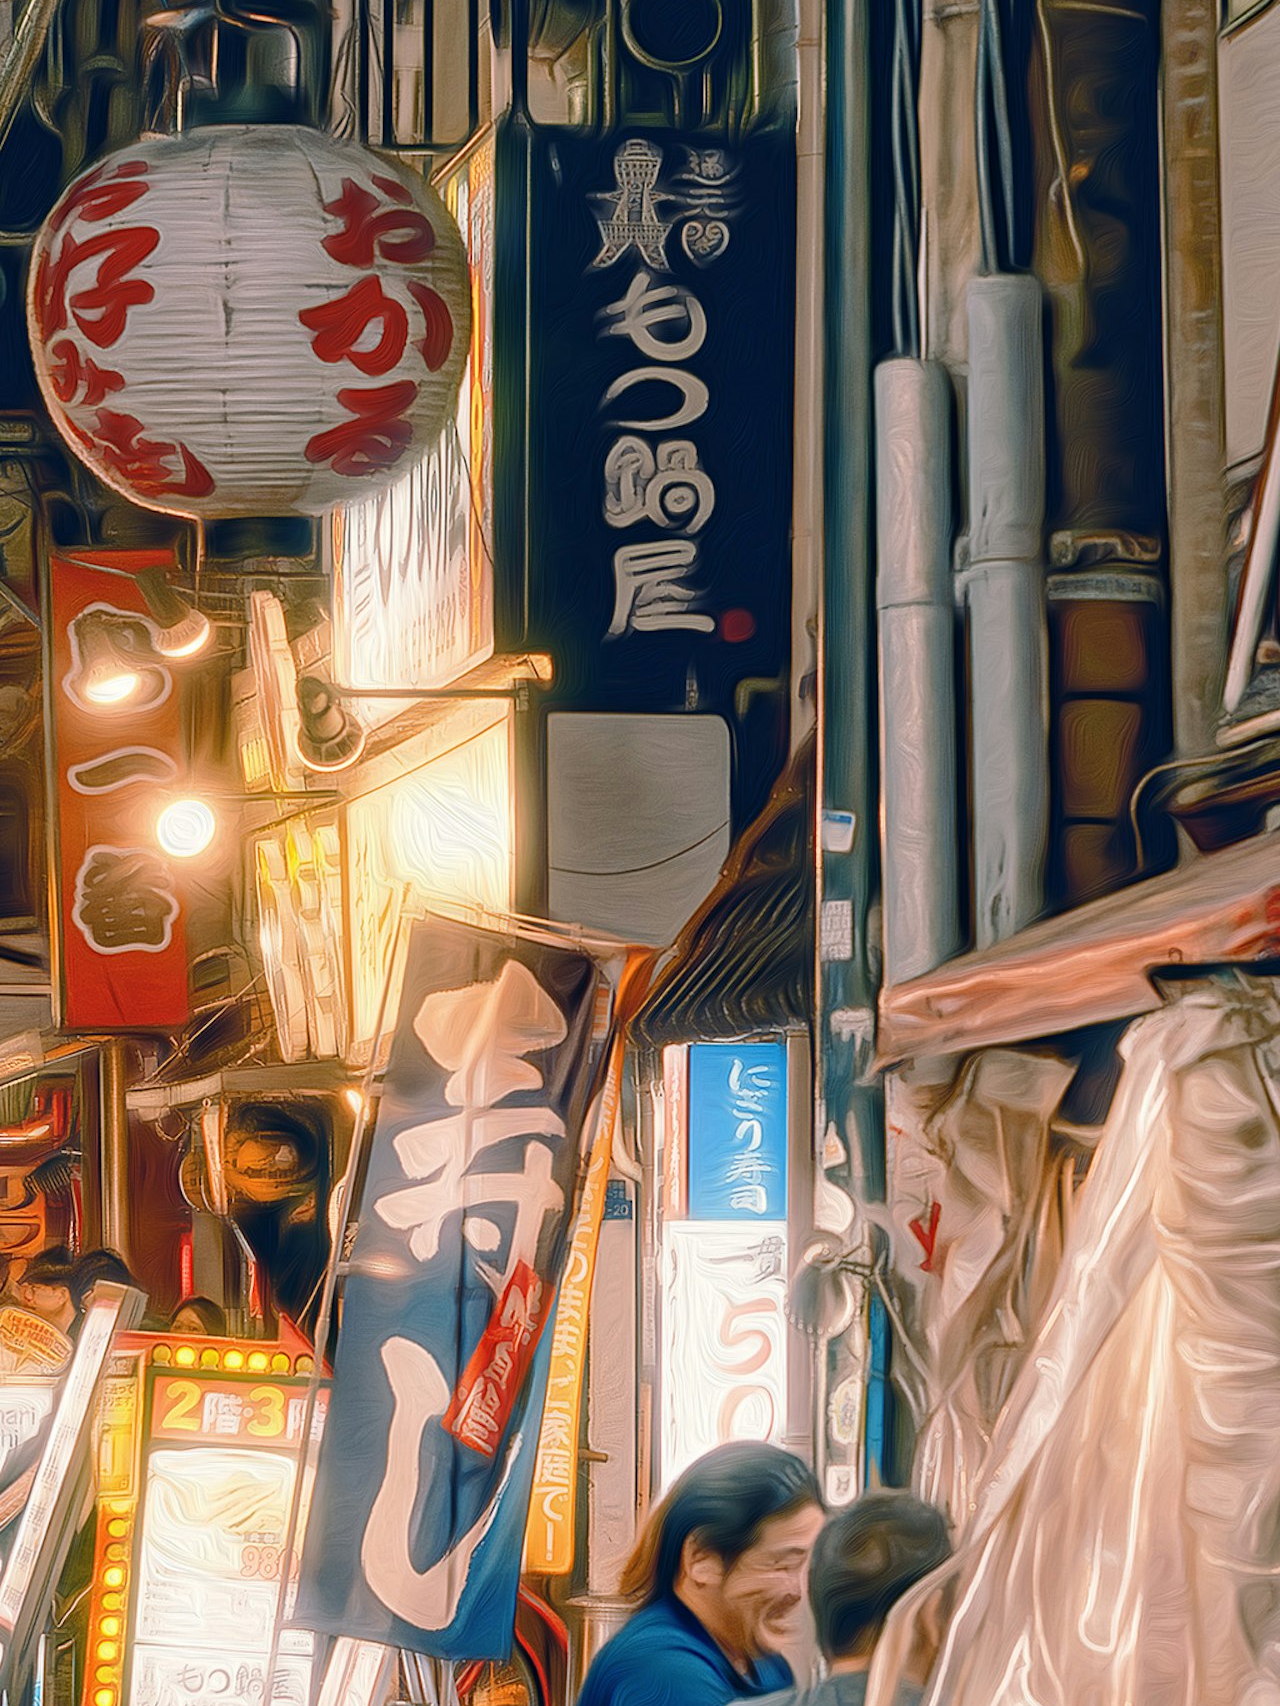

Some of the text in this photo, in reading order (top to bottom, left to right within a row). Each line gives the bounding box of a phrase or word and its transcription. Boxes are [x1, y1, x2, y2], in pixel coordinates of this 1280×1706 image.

[604, 270, 716, 637] もつ鍋屋
[726, 1057, 774, 1215] にぎり寿司
